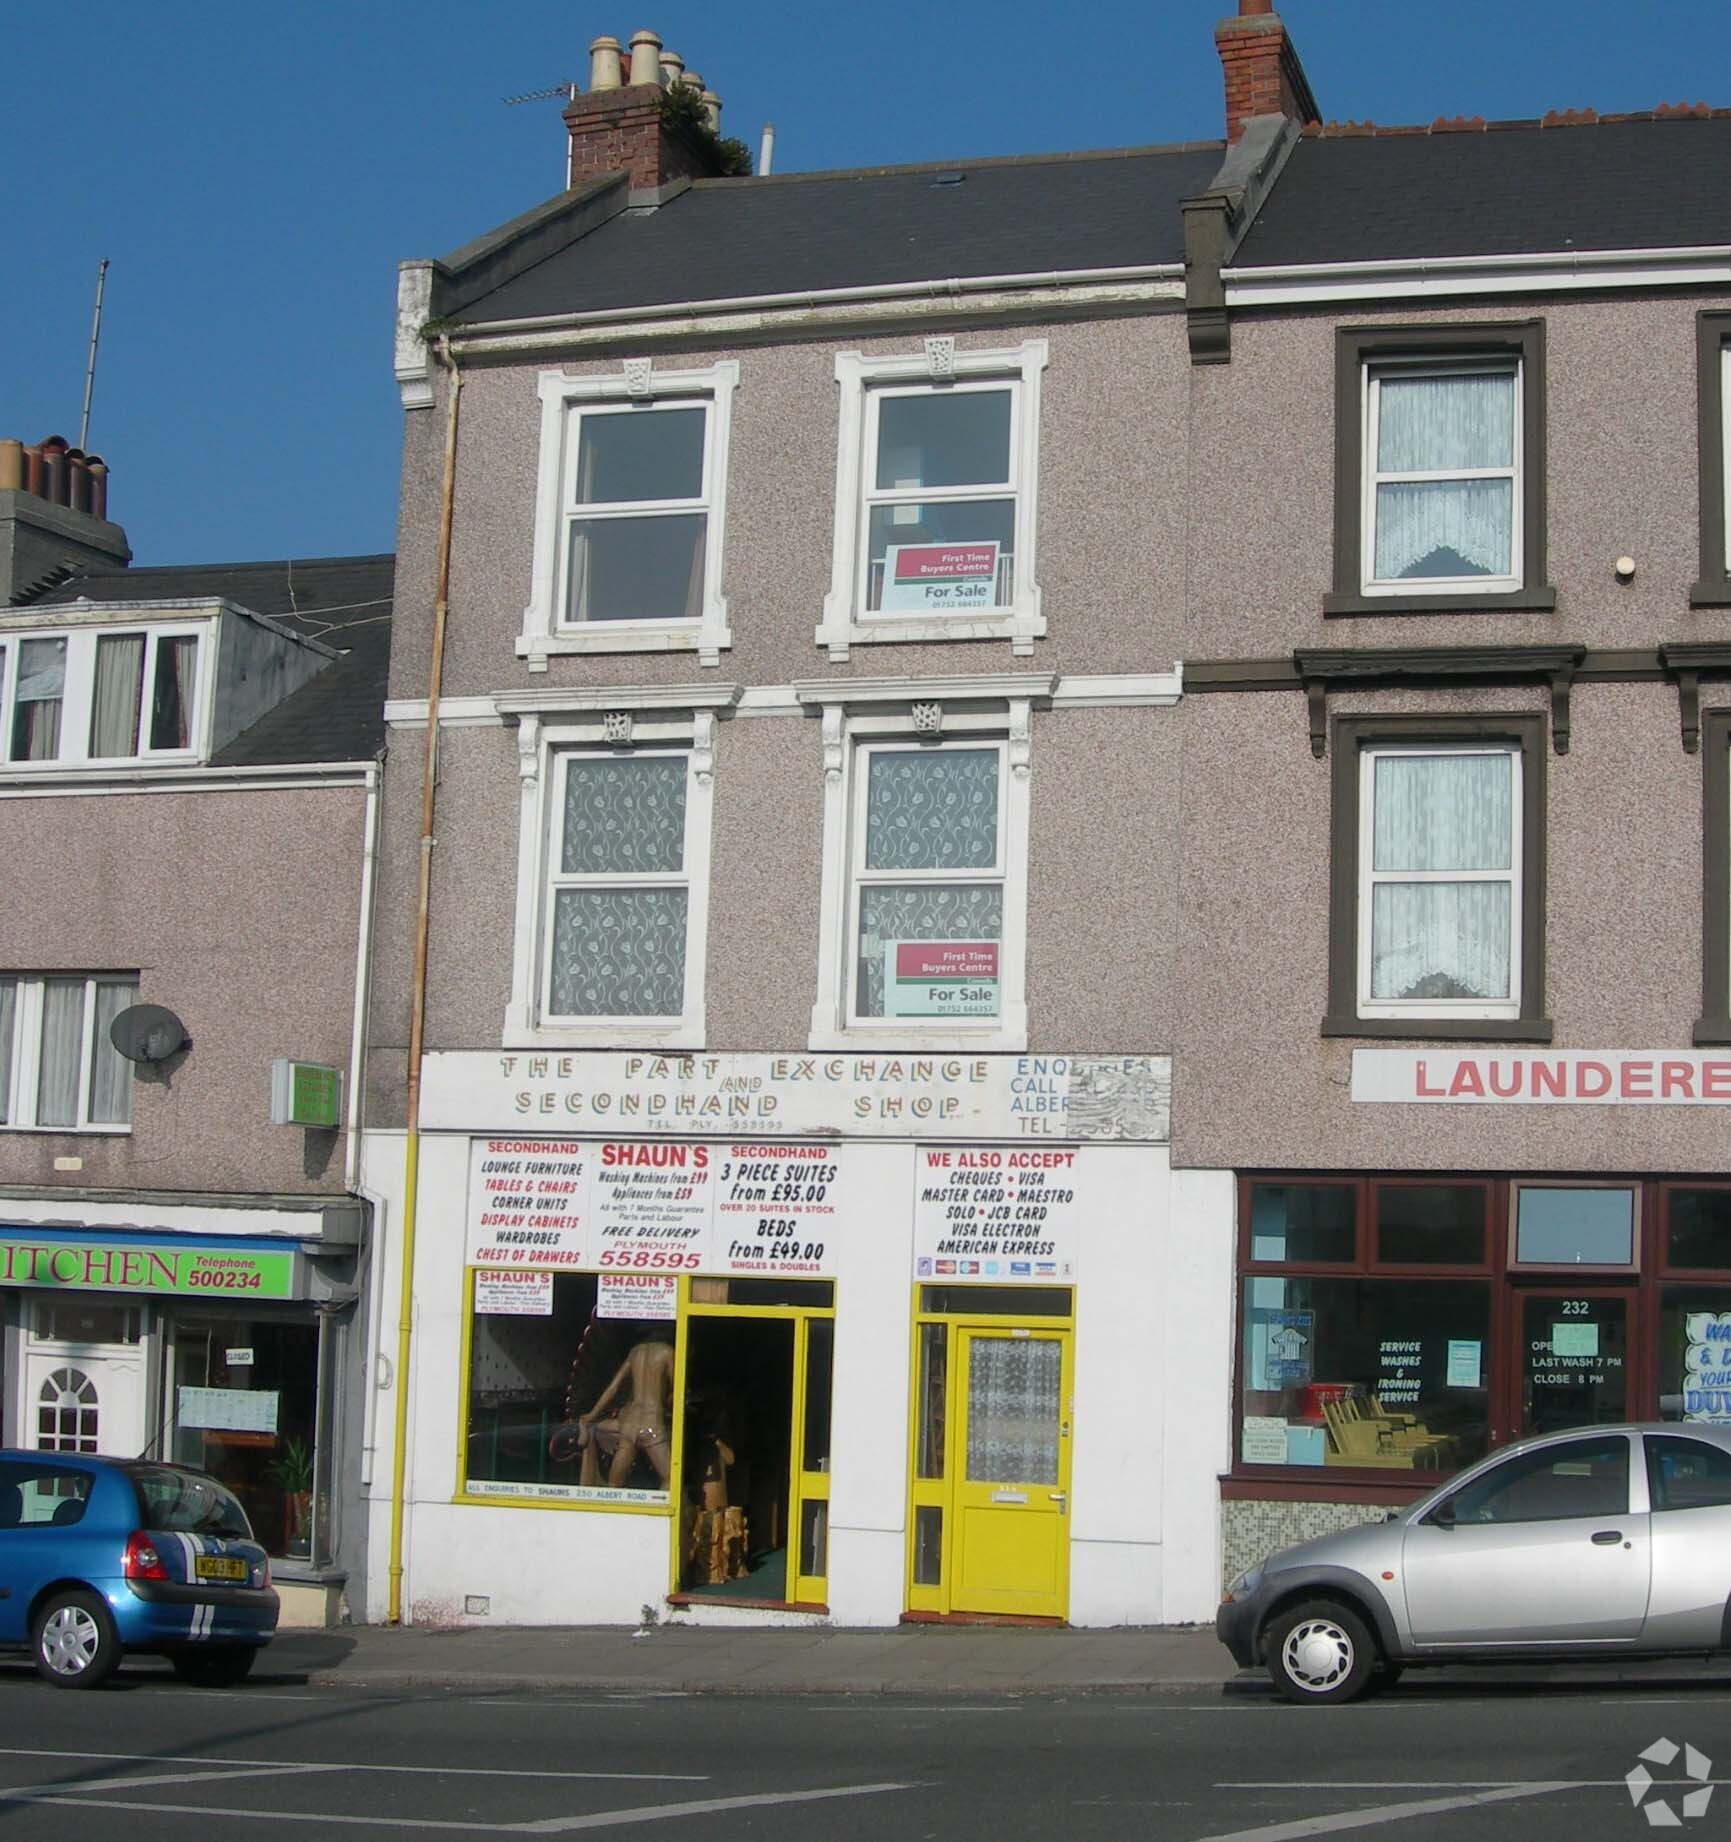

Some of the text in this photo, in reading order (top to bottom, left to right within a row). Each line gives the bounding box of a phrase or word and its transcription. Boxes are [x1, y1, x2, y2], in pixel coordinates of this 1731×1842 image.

[941, 553, 991, 563] First Time
[920, 562, 989, 574] Buyers Centre
[925, 584, 987, 598] For Sale
[943, 952, 993, 961] First Time
[921, 963, 993, 973] Buyers Centre
[929, 987, 993, 1001] For Sale
[500, 1057, 989, 1083] THE PART EXCHANGE
[719, 1076, 762, 1093] AND
[1010, 1078, 1057, 1094] CALL
[1415, 1060, 1731, 1098] LAUNDERE
[516, 1091, 960, 1119] SECONDHAND SHOP
[1018, 1117, 1052, 1134] TEL
[488, 1141, 579, 1154] SECONDHAND
[731, 1146, 828, 1159] SECONDHAND
[927, 1152, 1074, 1169] WE ALSO ACCEPT
[481, 1161, 583, 1176] LOUNGE FURNITURE
[721, 1163, 838, 1183] 3 PIECE SUITES
[599, 1171, 630, 1185] Washing
[632, 1171, 668, 1184] Machines
[671, 1172, 688, 1184] from
[950, 1171, 1045, 1186] CHEQUES VISA
[485, 1179, 578, 1194] TABLES & CHAIRS
[612, 1187, 653, 1200] Appliances
[654, 1188, 673, 1200] from
[730, 1183, 826, 1202] from £95.00
[921, 1188, 1074, 1203] MASTER CARD MAESTRO
[492, 1196, 568, 1210] CORNER UNITS
[666, 1205, 704, 1213] Guarantee
[720, 1203, 835, 1214] OVER 20 SUITES IN STOCK
[946, 1206, 1048, 1220] SOLO JCB CARD
[481, 1213, 579, 1228] DISPLAY CABINETS
[601, 1226, 700, 1238] FREE DELIVERY
[757, 1219, 797, 1237] BEDS
[951, 1223, 1041, 1238] VISA ELECTRON
[496, 1231, 561, 1245] WARDROBES
[614, 1241, 688, 1250] PLYMOUTH
[729, 1240, 825, 1260] from £49.00
[937, 1240, 1055, 1255] AMERICAN EXPRESS
[194, 1256, 256, 1269] Telephone
[476, 1248, 580, 1264] CHEST OF DRAWERS
[599, 1250, 702, 1269] 558595
[2, 1246, 180, 1287] ITCHEN
[731, 1261, 821, 1271] SINGLES & DOUBLES
[188, 1270, 261, 1289] 500234
[1562, 1301, 1589, 1314] 232
[1380, 1341, 1422, 1352] SERVICE
[1531, 1341, 1553, 1351] OPE
[1381, 1355, 1422, 1367] WASHES
[1532, 1358, 1622, 1367] LAST WASH 7 PM
[1700, 1347, 1712, 1366] &
[1378, 1379, 1421, 1389] IRONING
[1534, 1374, 1604, 1384] CLOSE 8 PM
[1378, 1391, 1420, 1402] SERVICE
[468, 1484, 480, 1492] ALL
[484, 1485, 520, 1494] ENQUIRIES
[524, 1486, 533, 1494] TO
[538, 1488, 570, 1497] SHAUNS
[597, 1490, 622, 1499] ALBERT
[627, 1492, 647, 1500] ROAD
